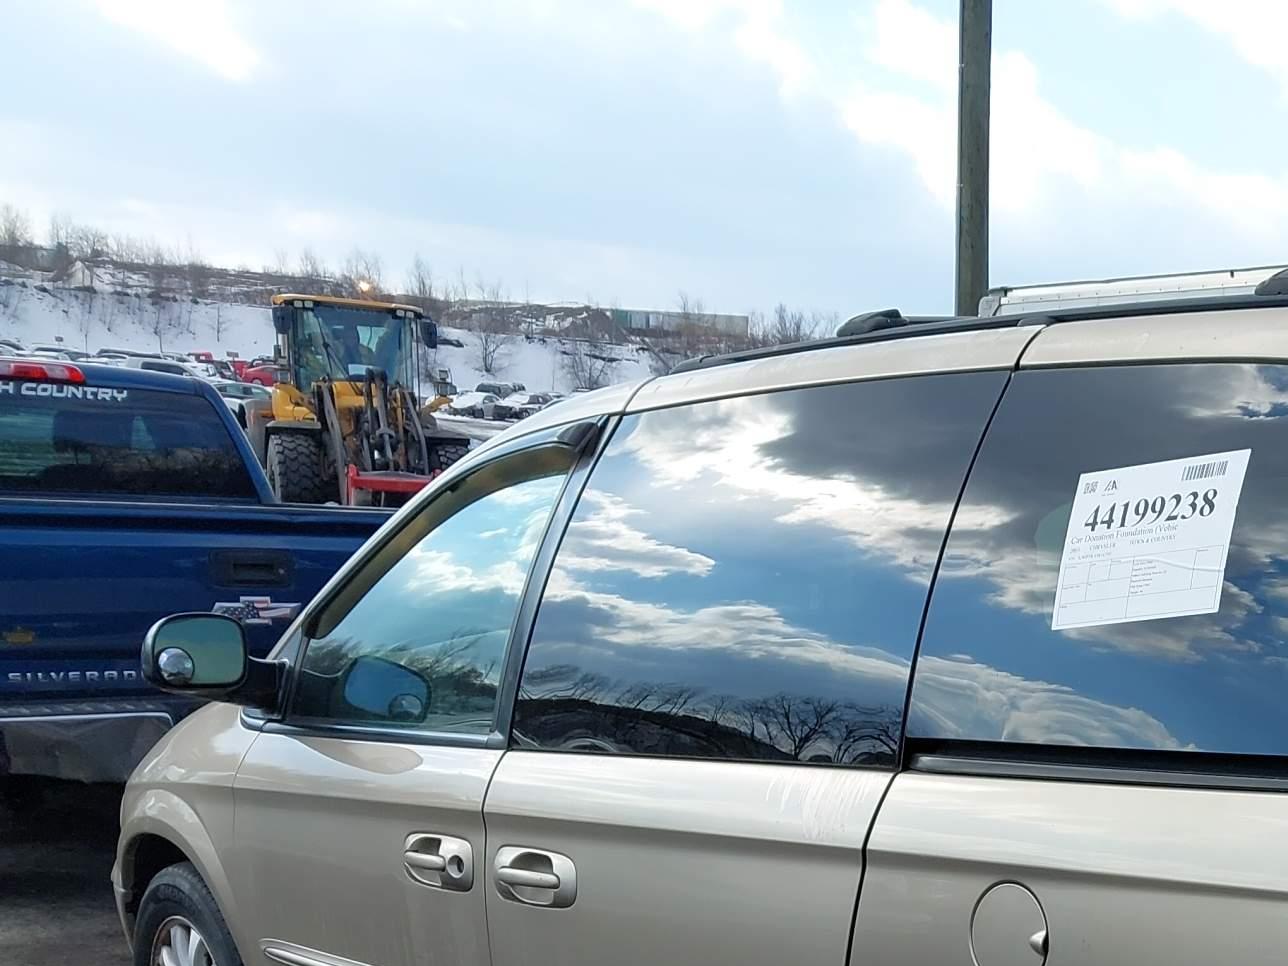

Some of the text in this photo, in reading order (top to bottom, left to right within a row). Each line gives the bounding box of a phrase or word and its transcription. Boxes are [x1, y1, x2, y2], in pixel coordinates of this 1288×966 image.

[21, 382, 128, 402] COUNTRY
[1084, 488, 1218, 532] 44199238
[1084, 531, 1114, 543] Donation
[1115, 525, 1153, 538] Foundation
[8, 670, 145, 683] SILVERAD
